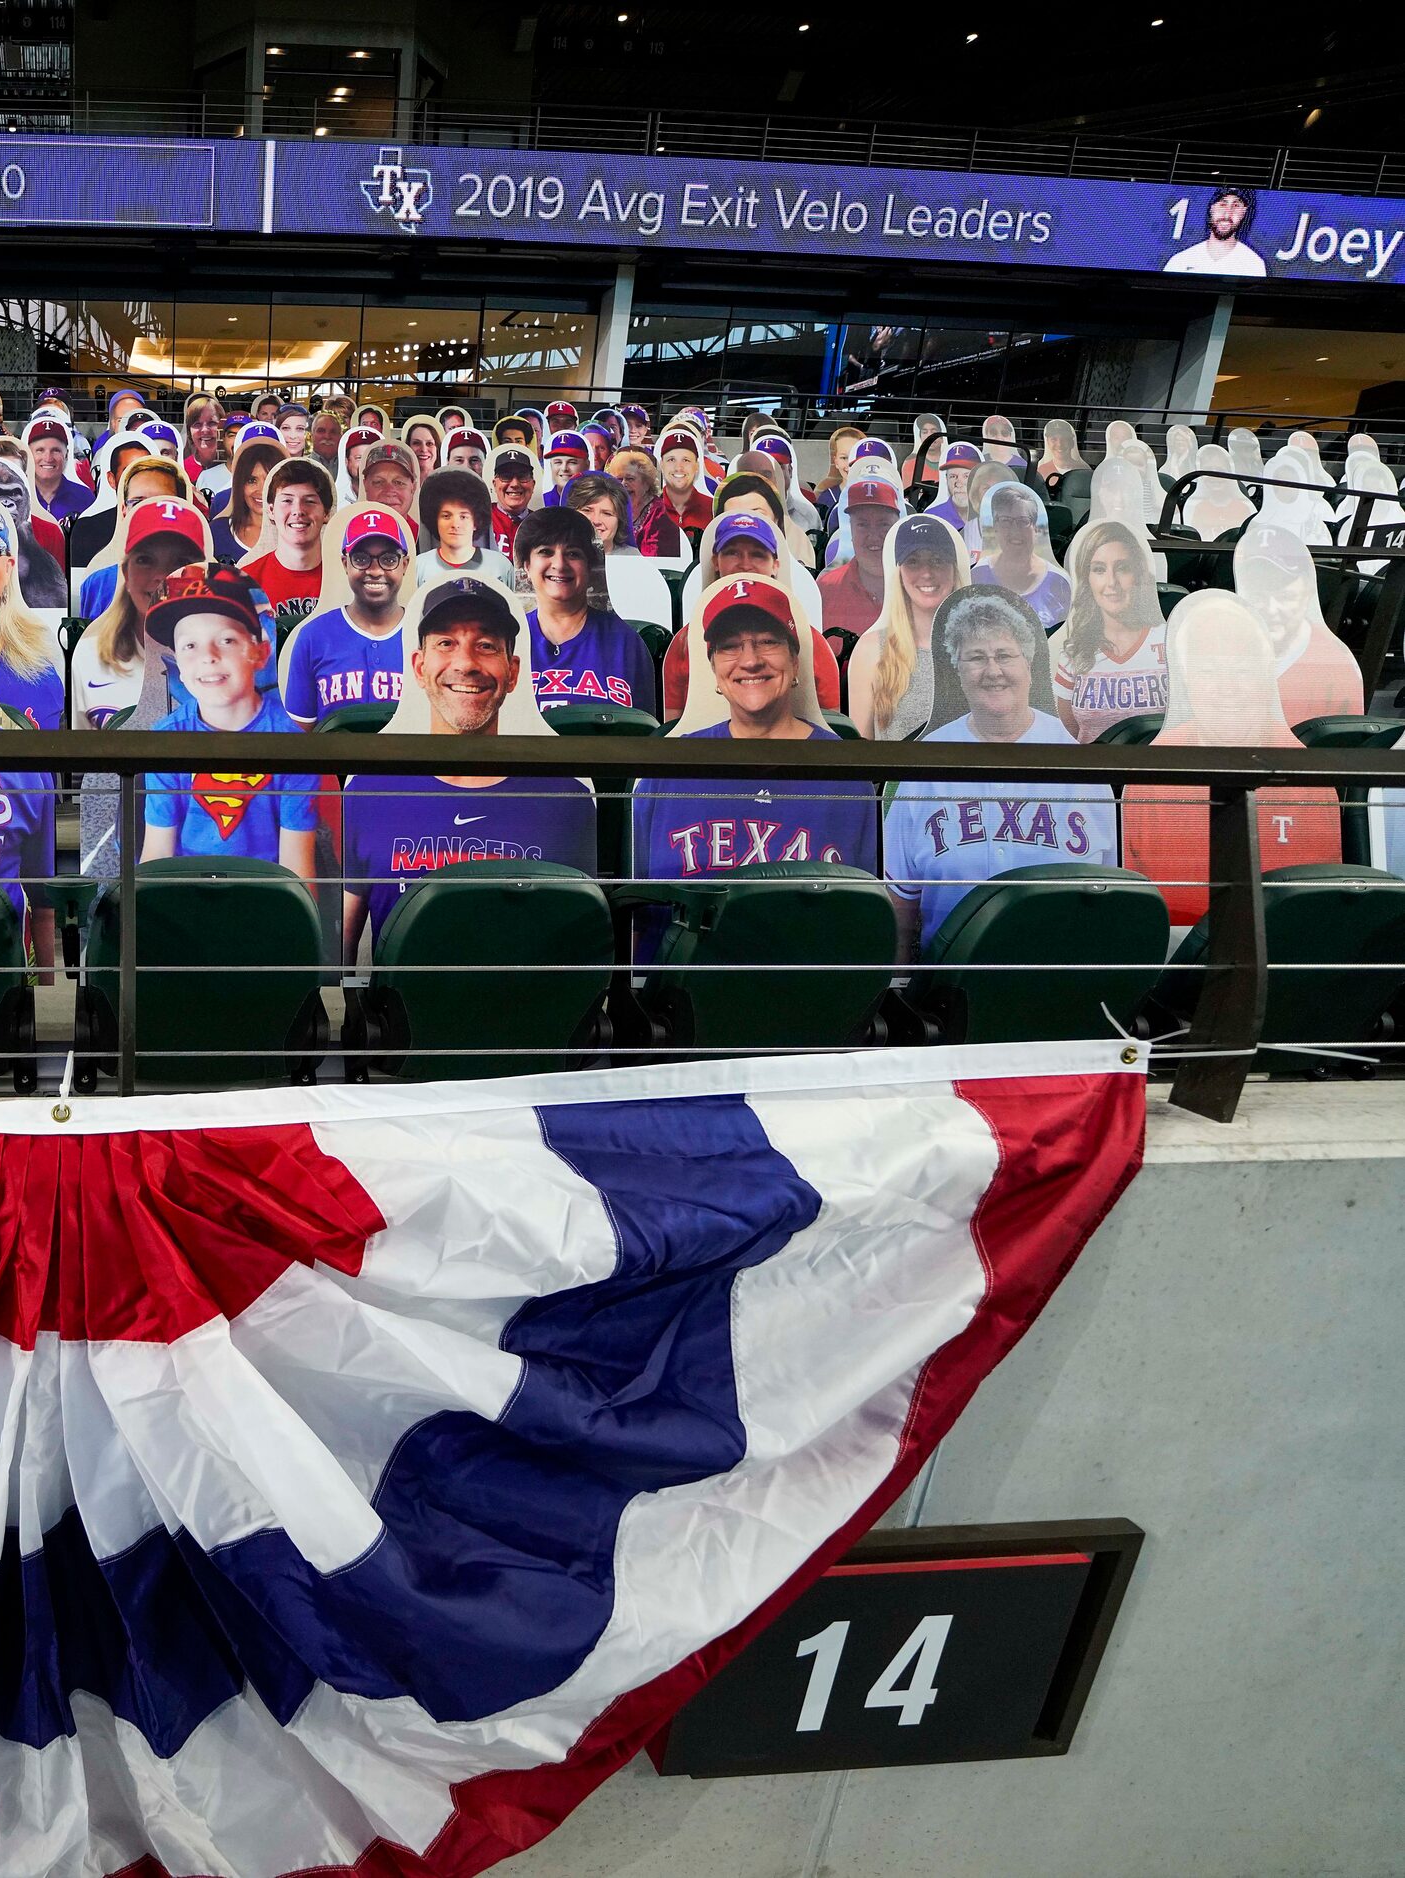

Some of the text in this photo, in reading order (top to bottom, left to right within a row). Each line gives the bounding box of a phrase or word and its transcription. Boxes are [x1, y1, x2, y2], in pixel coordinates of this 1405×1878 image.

[455, 172, 1052, 244] 2019 Avg Exit Velo Leaders
[1168, 198, 1404, 279] 1 Joey
[42, 421, 53, 430] T
[152, 424, 163, 434] T
[255, 425, 266, 435] T
[359, 430, 370, 440] T
[461, 431, 472, 440] T
[557, 434, 570, 444] T
[673, 434, 685, 443] T
[762, 439, 774, 449] T
[862, 442, 874, 452] T
[507, 450, 519, 460] T
[953, 446, 964, 456] T
[861, 483, 878, 497] T
[156, 501, 183, 521] T
[363, 513, 381, 528] T
[1385, 531, 1404, 550] 14
[727, 579, 755, 599] T
[276, 598, 320, 617] ANG
[924, 799, 1090, 857] TEXAS
[1272, 815, 1293, 843] T
[796, 1614, 954, 1732] 14
